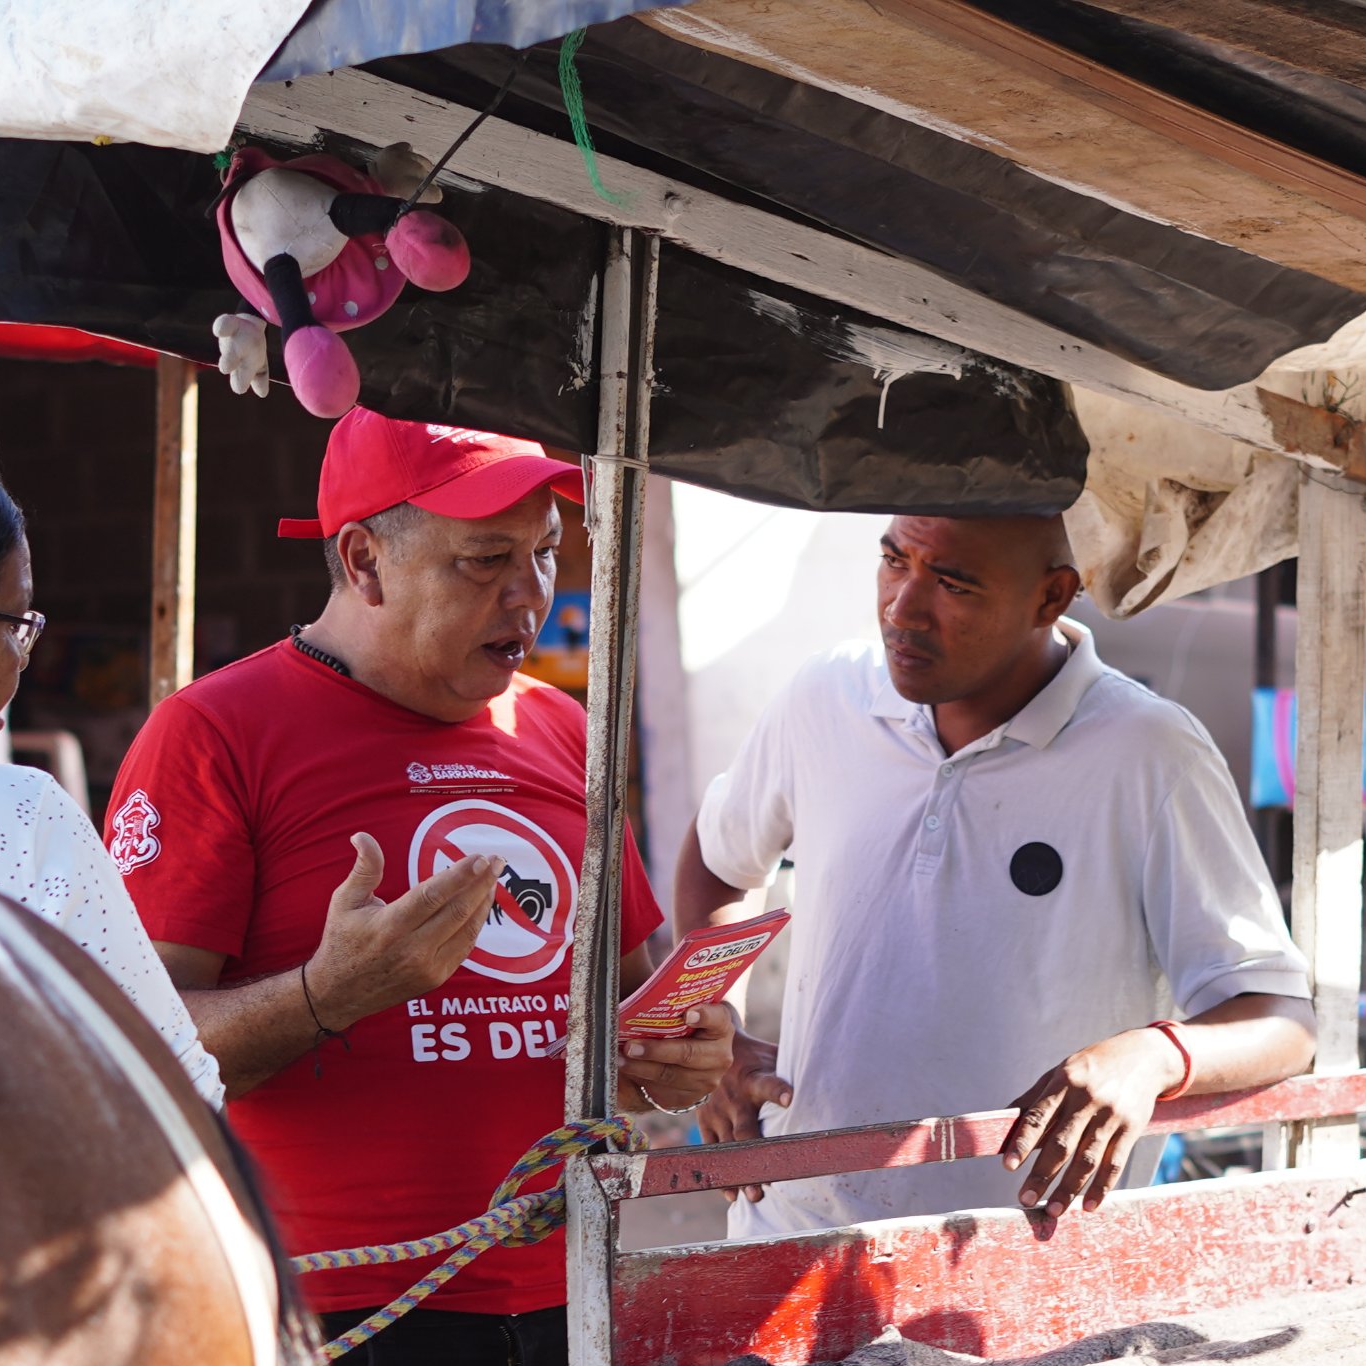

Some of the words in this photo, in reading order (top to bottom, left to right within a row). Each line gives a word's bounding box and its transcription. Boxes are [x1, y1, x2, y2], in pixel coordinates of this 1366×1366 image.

[433, 770, 514, 779] BARRANQUIL
[707, 951, 723, 961] ES
[723, 941, 761, 958] DELITO
[676, 959, 744, 983] Restricción
[407, 998, 434, 1017] EL
[441, 995, 548, 1016] MALTRATO
[411, 1022, 471, 1062] ES
